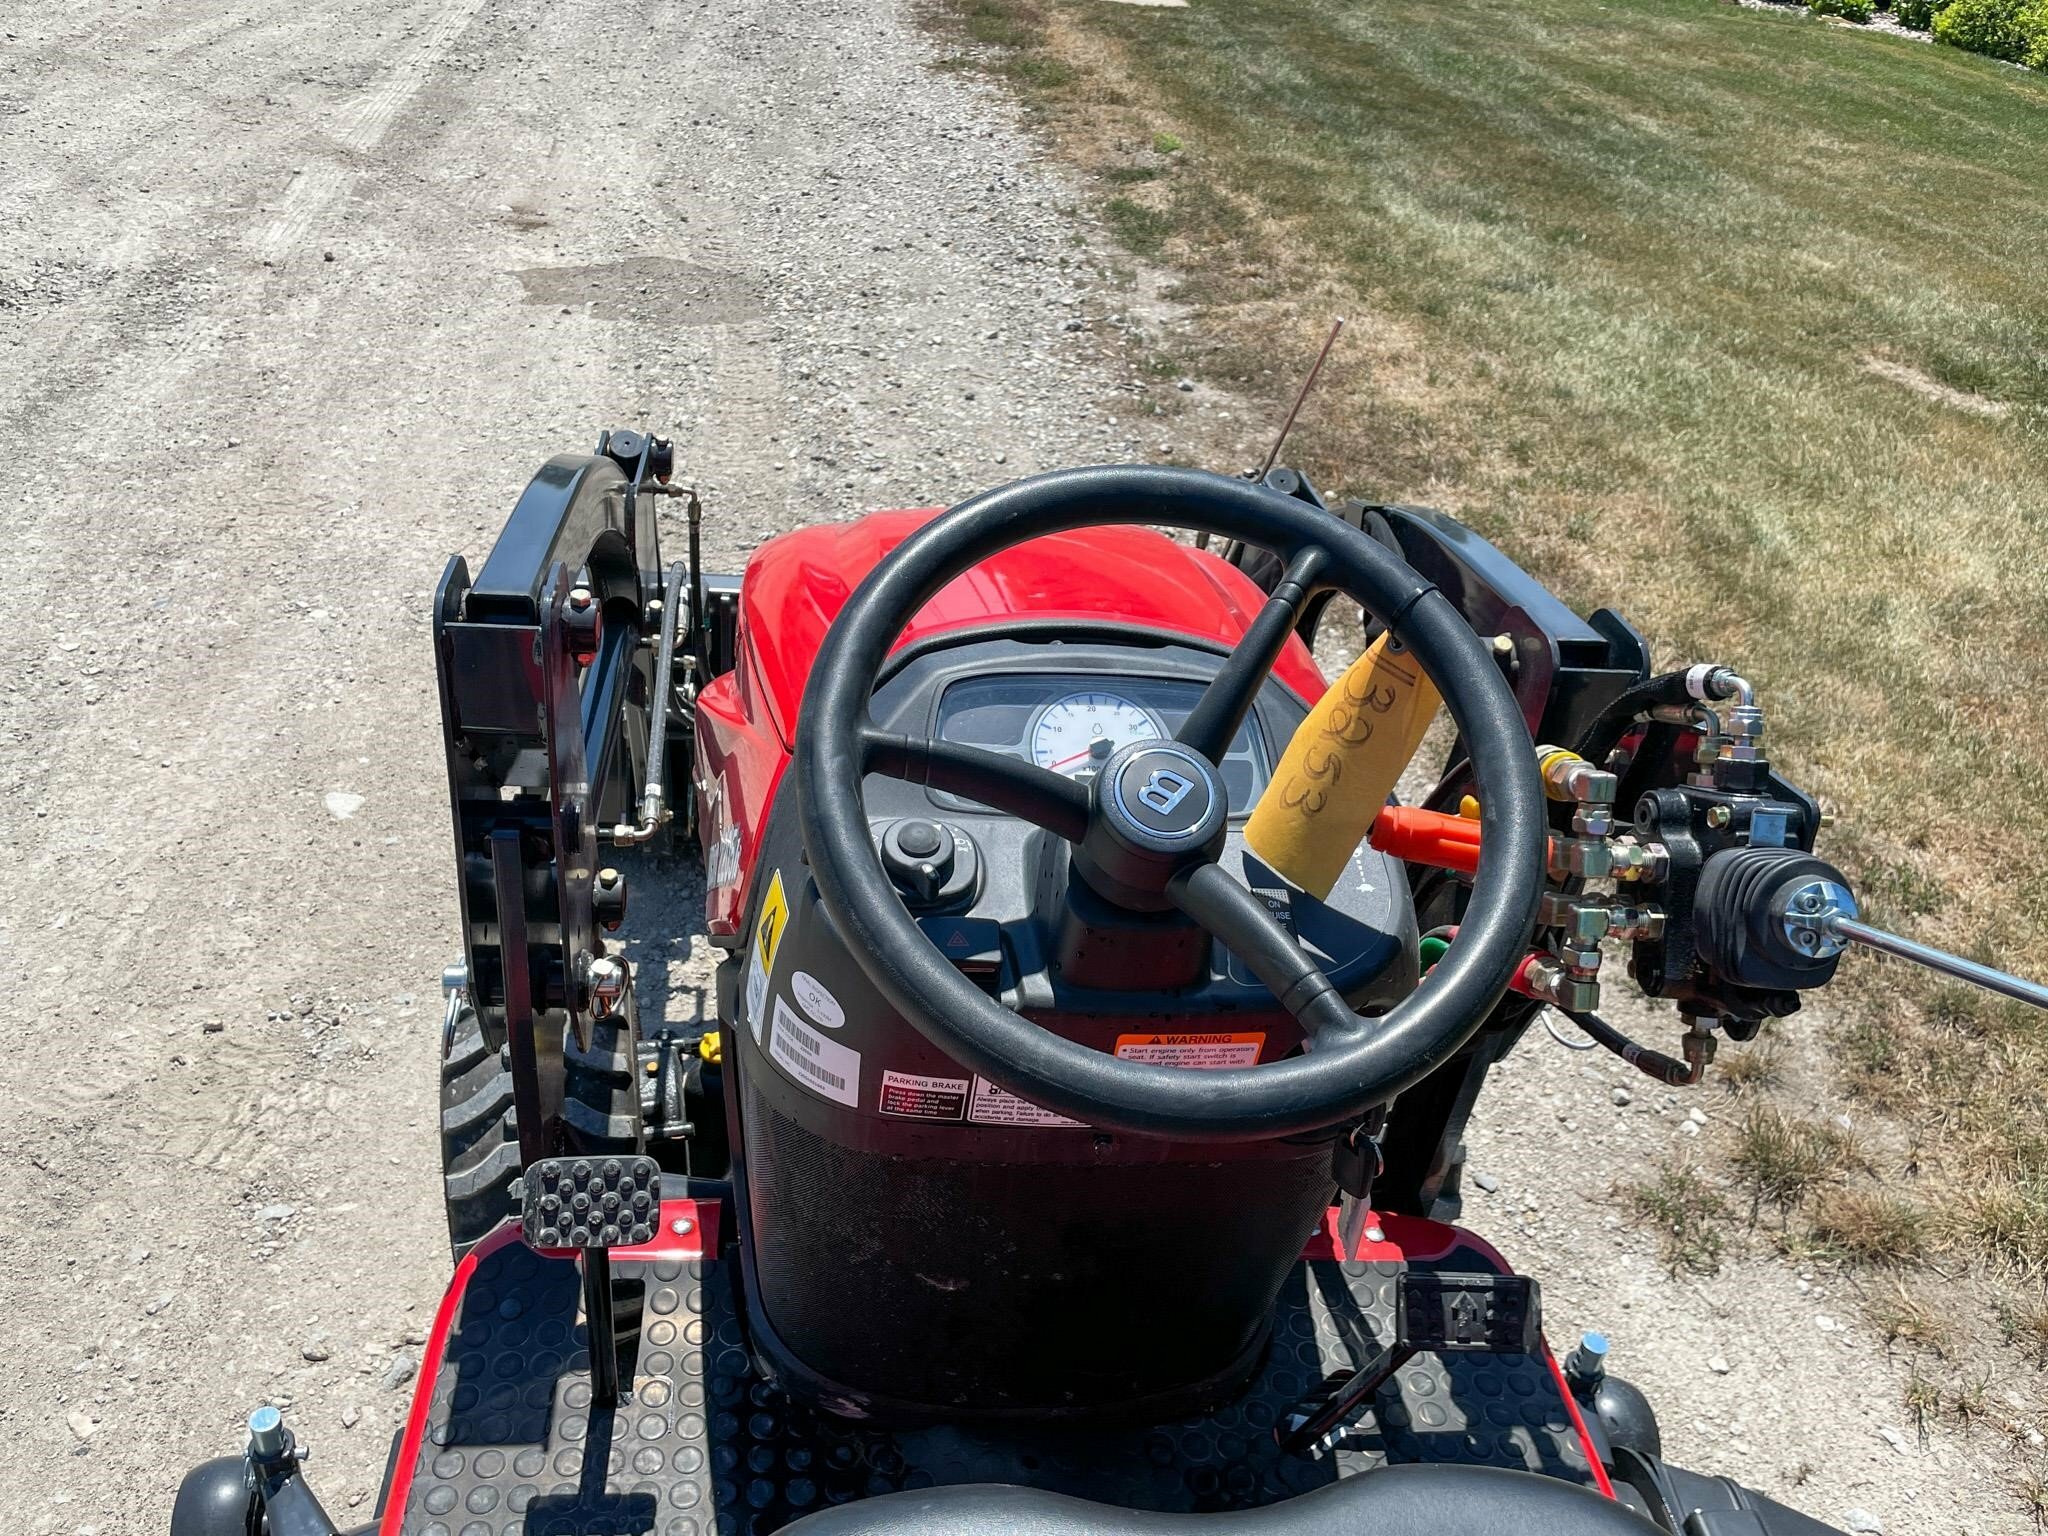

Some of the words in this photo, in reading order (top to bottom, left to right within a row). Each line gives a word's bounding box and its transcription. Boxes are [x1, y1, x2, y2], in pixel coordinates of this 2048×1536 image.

[808, 992, 822, 1007] OK
[1167, 1035, 1232, 1044] WARNING
[888, 1075, 928, 1087] PARKING
[932, 1081, 963, 1090] BRAKE
